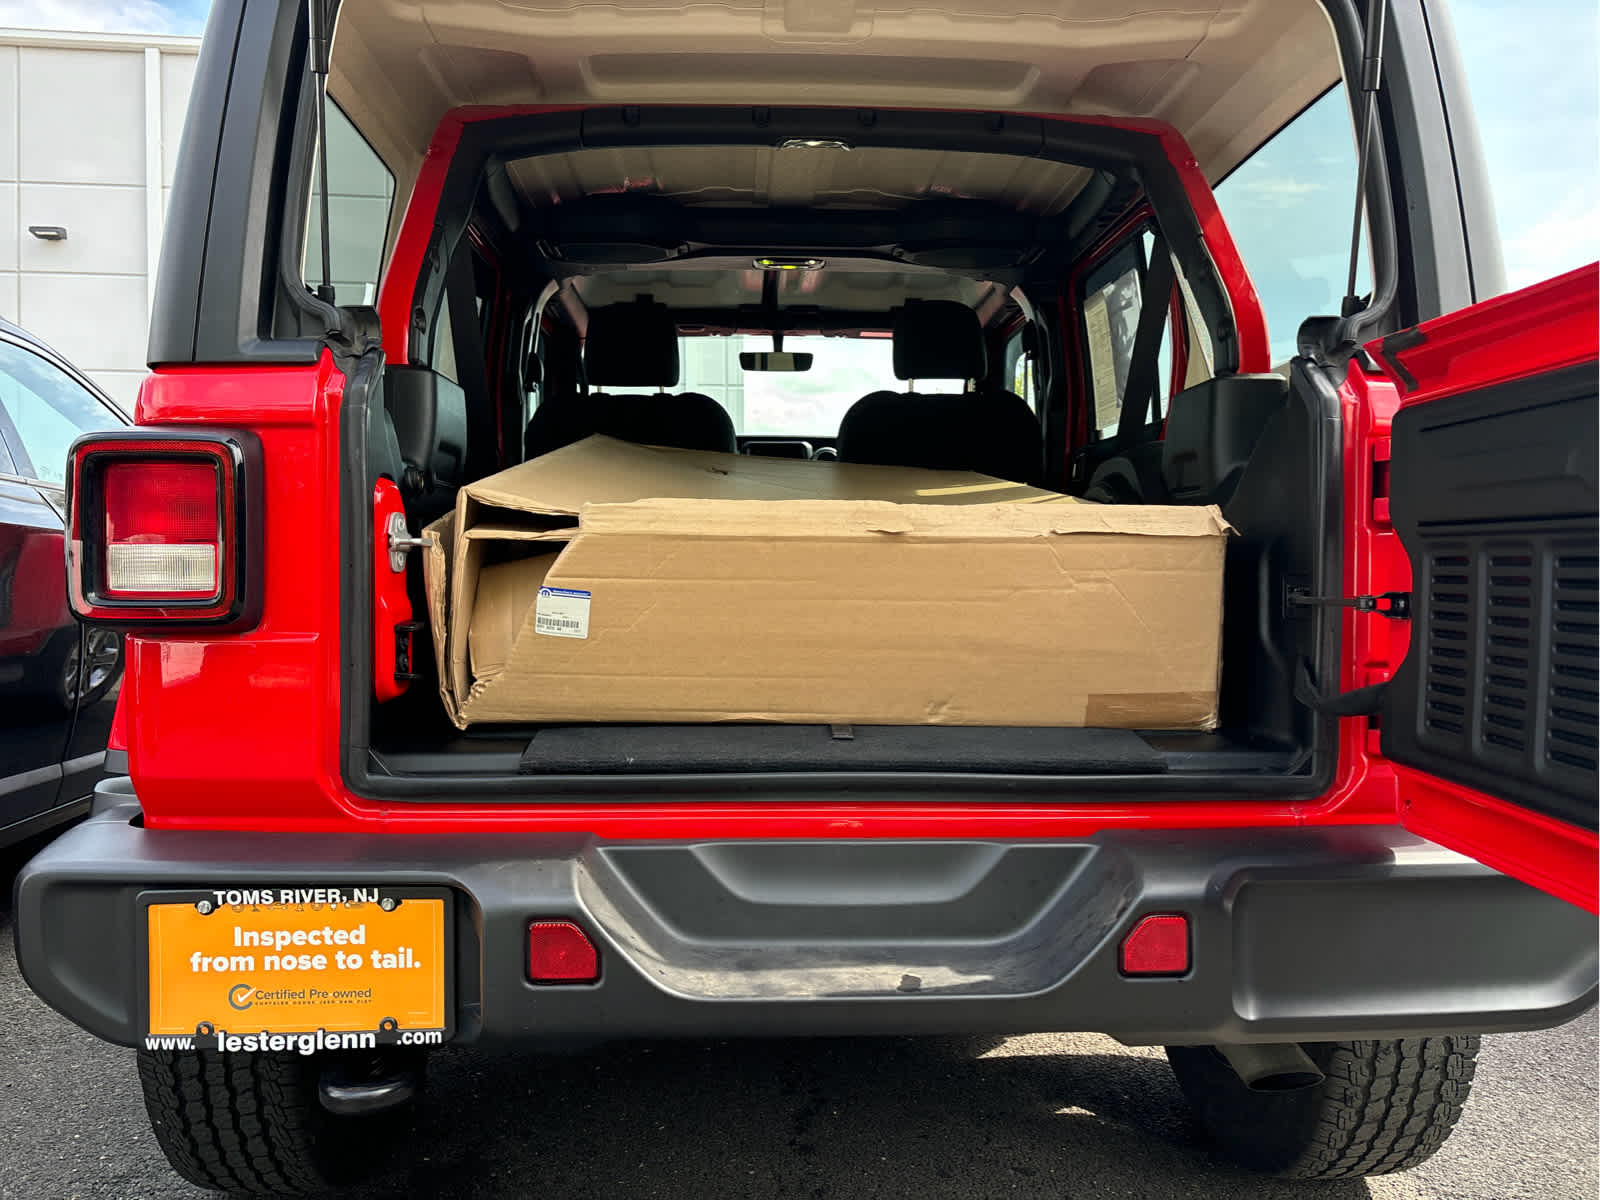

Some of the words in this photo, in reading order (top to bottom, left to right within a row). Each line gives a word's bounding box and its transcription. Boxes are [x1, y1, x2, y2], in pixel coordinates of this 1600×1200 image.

[213, 889, 274, 905] TOMS
[280, 888, 347, 904] RIVER,
[353, 888, 379, 903] NJ
[234, 924, 366, 951] Inspected
[190, 951, 254, 972] from
[264, 954, 328, 970] nose
[335, 950, 363, 970] to
[370, 946, 421, 969] tail.
[255, 989, 306, 1000] Certified
[309, 988, 372, 999] Pre-owned
[145, 1037, 196, 1051] www.
[218, 1029, 376, 1056] lesterglenn
[396, 1030, 442, 1045] .com
